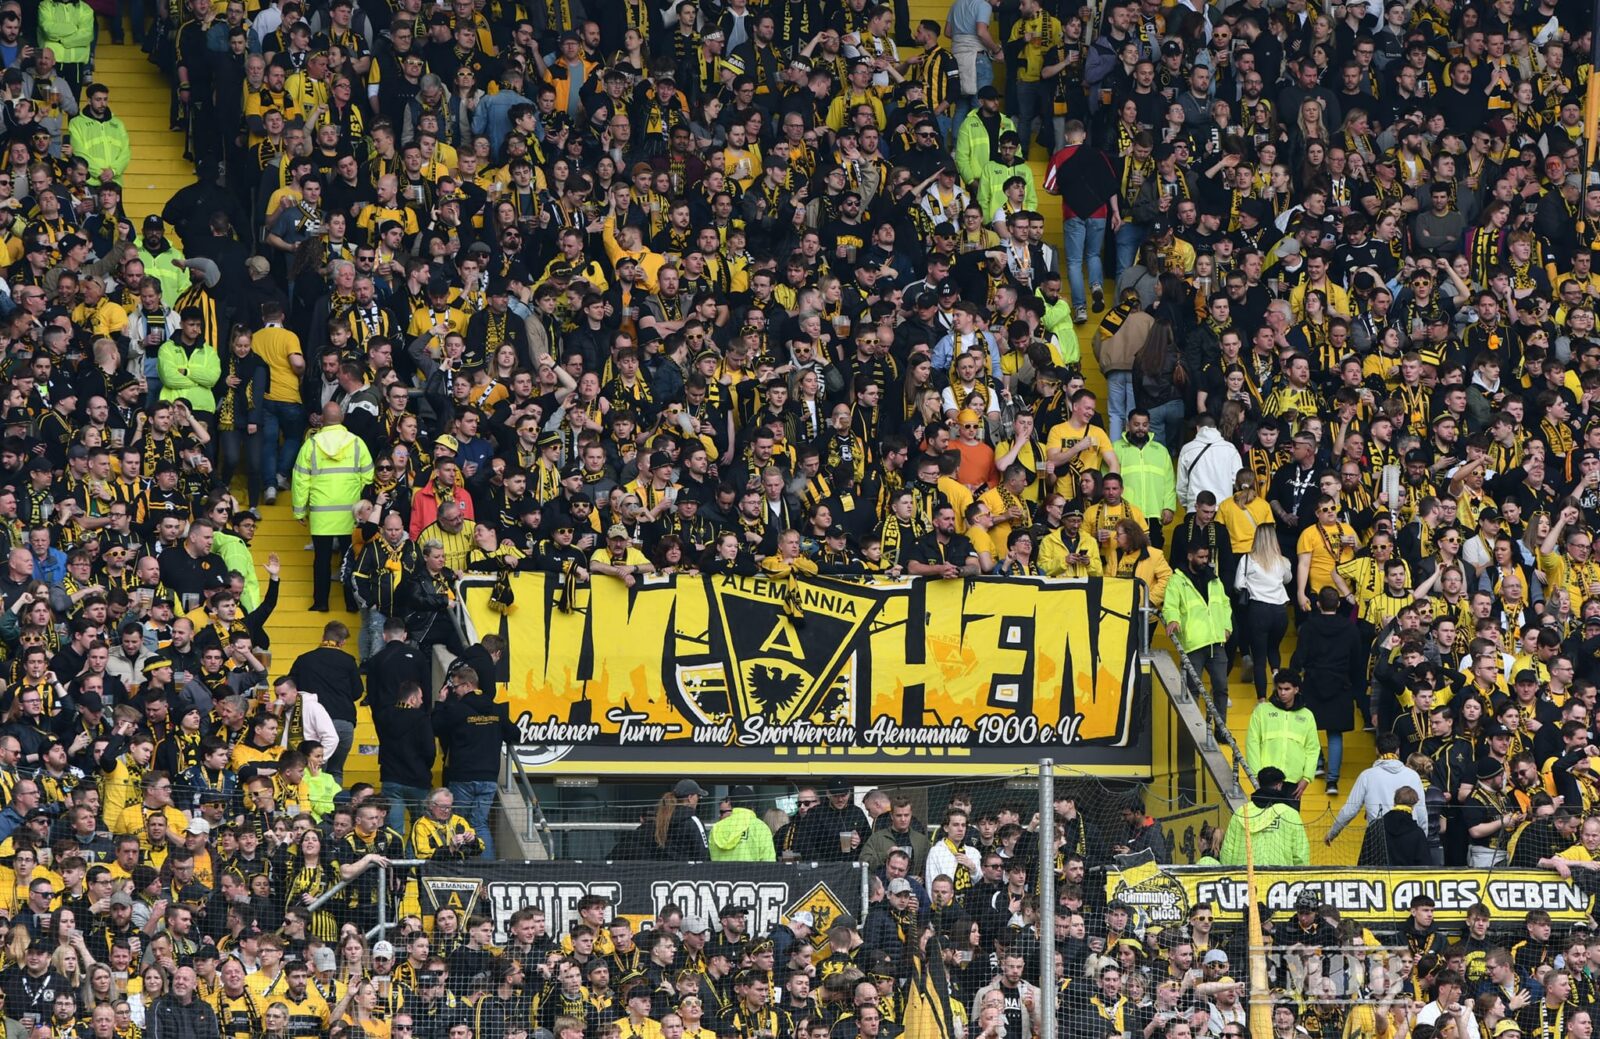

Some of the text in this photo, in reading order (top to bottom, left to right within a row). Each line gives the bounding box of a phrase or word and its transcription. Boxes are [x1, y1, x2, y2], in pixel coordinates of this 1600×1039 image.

[722, 573, 857, 618] ALEMNNIA
[516, 709, 1084, 745] Aachener Turn- und Sportverein Alemannia 1900 e.V.
[431, 882, 476, 891] ALEMANNIA
[1199, 878, 1251, 909] FÜR
[1395, 881, 1479, 909] ALLES
[1491, 881, 1589, 909] GEBEN!
[1151, 906, 1181, 920] block
